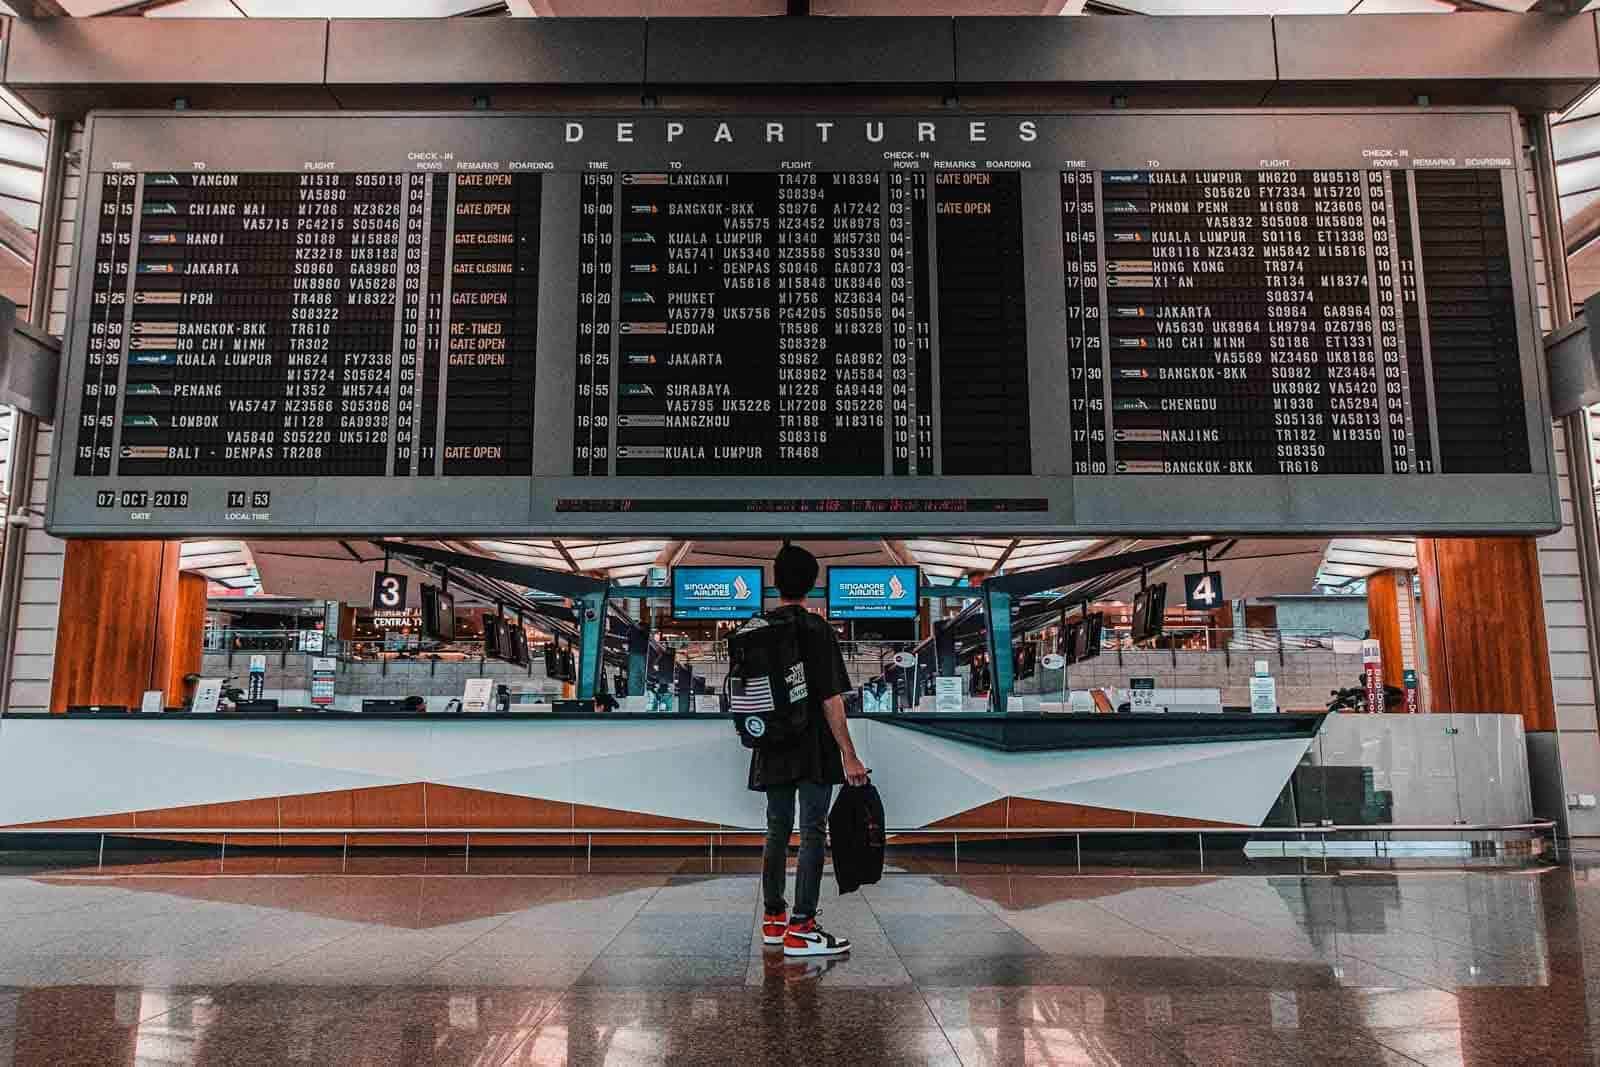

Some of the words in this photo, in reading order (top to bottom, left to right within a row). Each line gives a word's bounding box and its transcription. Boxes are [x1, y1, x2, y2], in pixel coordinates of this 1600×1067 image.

[565, 122, 1038, 142] DEPARTURES
[192, 175, 238, 186] YANGON
[458, 175, 482, 185] GATE
[485, 175, 512, 185] OPEN
[669, 174, 729, 185] LANGKAWI
[936, 173, 961, 184] GATE
[963, 173, 990, 184] OPEN
[1149, 173, 1187, 183] KUALA
[1196, 173, 1242, 183] LUMPUR
[190, 204, 236, 215] CHIANG
[243, 204, 265, 215] MAI
[456, 204, 481, 214] GATE
[484, 204, 510, 215] OPEN
[937, 203, 962, 214] GATE
[964, 203, 991, 213] OPEN
[1150, 202, 1189, 213] PHNOM
[1198, 202, 1228, 213] PENH
[186, 233, 224, 244] HANOI
[455, 234, 476, 244] GATE
[478, 234, 513, 243] CLOSING
[668, 233, 707, 244] KUALA
[716, 233, 762, 244] LUMPUR
[1152, 232, 1191, 243] KUALA
[1200, 231, 1246, 242] LUMPUR
[184, 263, 239, 274] JAKARTA
[454, 264, 475, 273] GATE
[477, 264, 512, 273] CLOSING
[668, 263, 697, 274] BALI
[723, 263, 770, 274] DENPAS
[1153, 262, 1184, 272] HONG
[1193, 261, 1224, 272] KONG
[183, 293, 213, 304] IPOH
[452, 293, 477, 304] GATE
[480, 293, 507, 304] OPEN
[668, 293, 715, 304] PHUKET
[1157, 307, 1211, 318] JAKARTA
[668, 323, 714, 334] JEDDAH
[178, 339, 193, 350] HO
[202, 338, 223, 350] CHI
[233, 338, 265, 350] MINH
[450, 338, 475, 349] GATE
[478, 338, 505, 349] OPEN
[1158, 337, 1173, 348] HO
[1182, 337, 1203, 348] CHI
[1214, 337, 1245, 348] MINH
[176, 354, 216, 365] KUALA
[224, 354, 272, 365] LUMPUR
[450, 354, 475, 365] GATE
[478, 354, 505, 365] OPEN
[667, 354, 722, 365] JAKARTA
[174, 385, 222, 396] PENANG
[667, 384, 730, 396] SURABAYA
[1161, 399, 1217, 410] CHENGDU
[171, 416, 218, 427] LOMBOK
[666, 416, 730, 427] HANGZHOU
[1161, 430, 1219, 441] NANJING
[168, 447, 199, 459] BALI
[225, 447, 273, 458] DENPAS
[445, 447, 470, 458] GATE
[474, 447, 501, 458] OPEN
[666, 447, 705, 458] KUALA
[714, 447, 762, 458] LUMPUR
[381, 577, 400, 606] 3
[1193, 576, 1216, 605] 4
